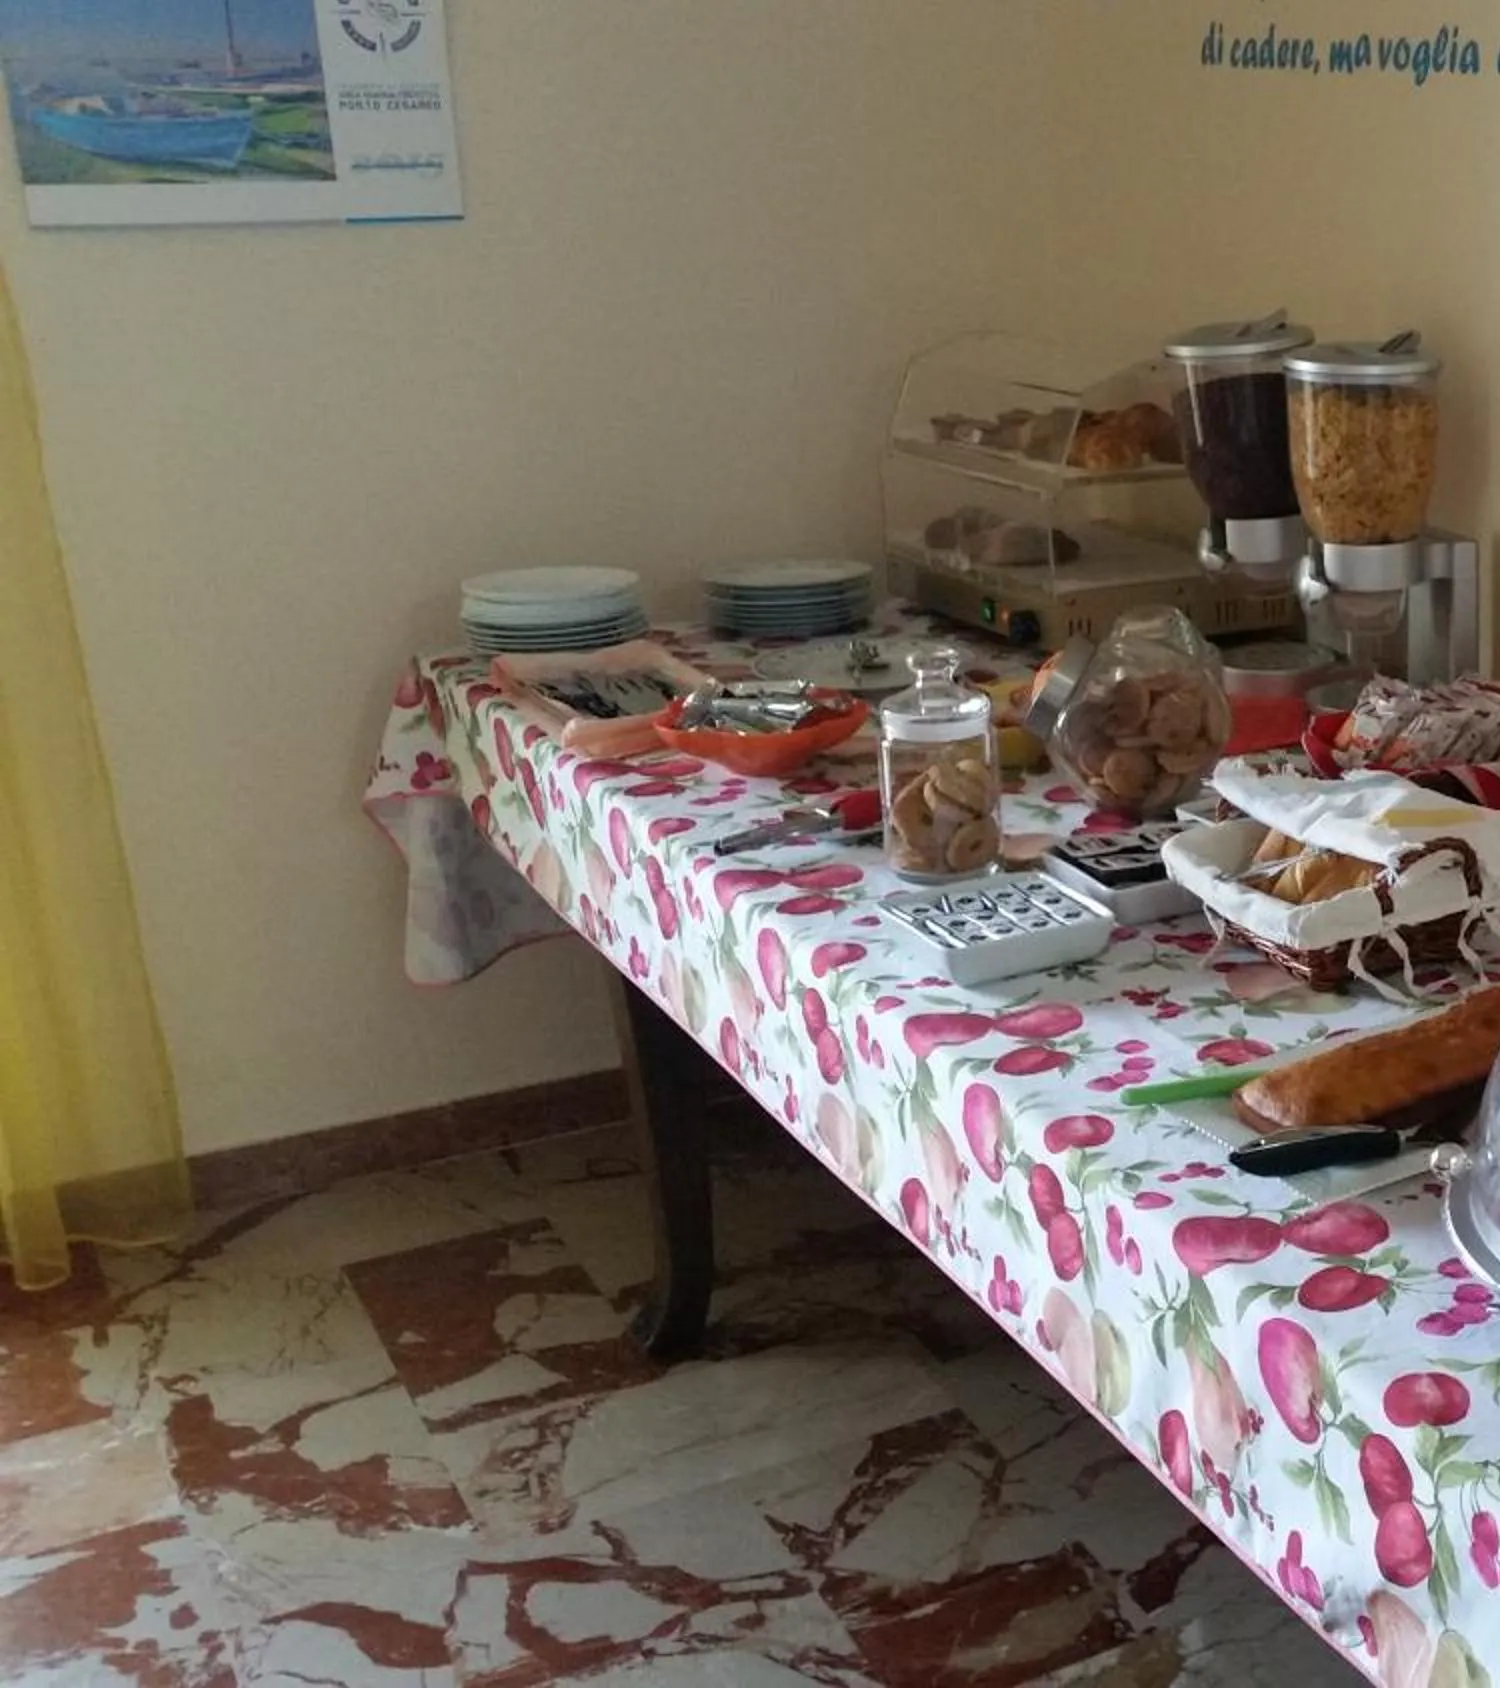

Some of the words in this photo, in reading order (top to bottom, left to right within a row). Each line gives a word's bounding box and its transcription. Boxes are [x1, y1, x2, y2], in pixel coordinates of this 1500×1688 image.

[1201, 20, 1223, 66] di
[1230, 23, 1320, 75] cadere,
[1330, 33, 1372, 73] ma
[1378, 24, 1481, 87] voglia
